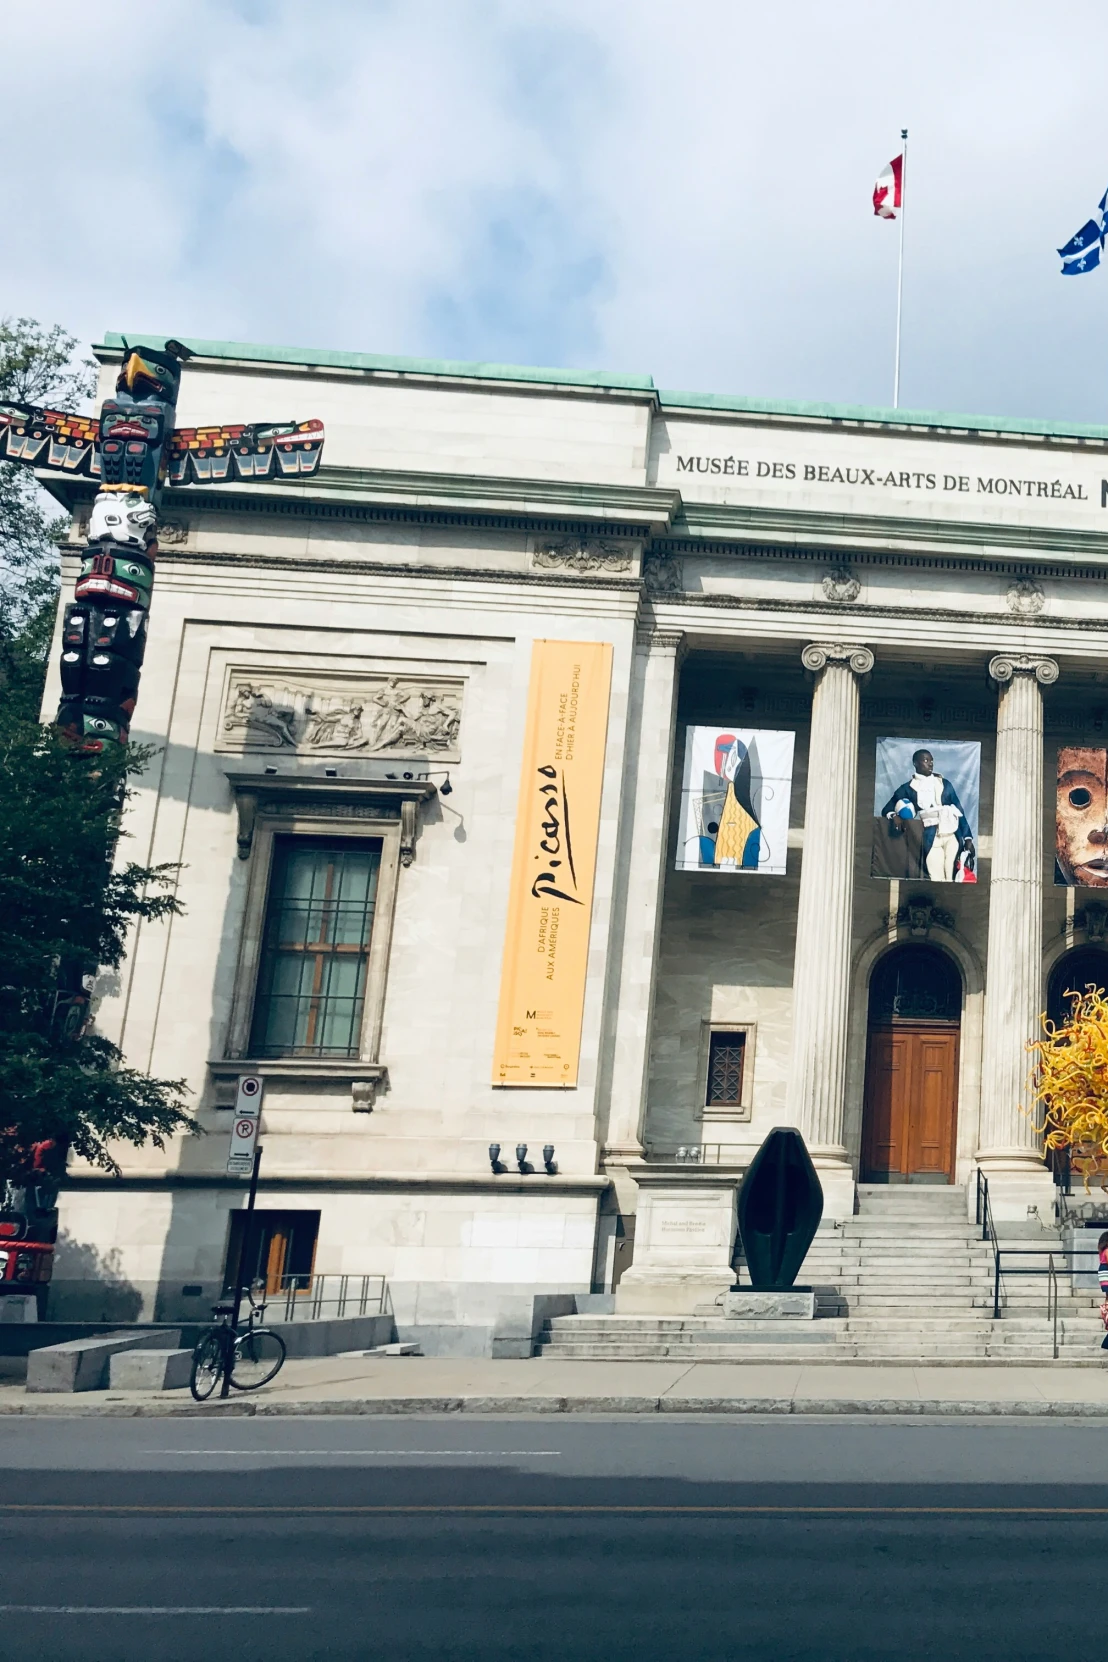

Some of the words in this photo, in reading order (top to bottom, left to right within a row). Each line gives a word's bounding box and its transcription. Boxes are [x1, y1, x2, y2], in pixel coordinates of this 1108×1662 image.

[676, 455, 749, 476] MUSÉE
[756, 461, 796, 479] DES
[803, 464, 936, 490] BEAUX-ARTS
[943, 475, 970, 492] DE
[977, 477, 1088, 500] MONTRÉAL
[568, 664, 581, 723] AUJOURD'HUI
[556, 693, 568, 747] FACE-À-FACE
[554, 749, 563, 760] EN
[537, 906, 550, 953] D'AFRIQUE
[548, 907, 561, 959] AMÉRIQUES
[546, 960, 555, 981] AUX
